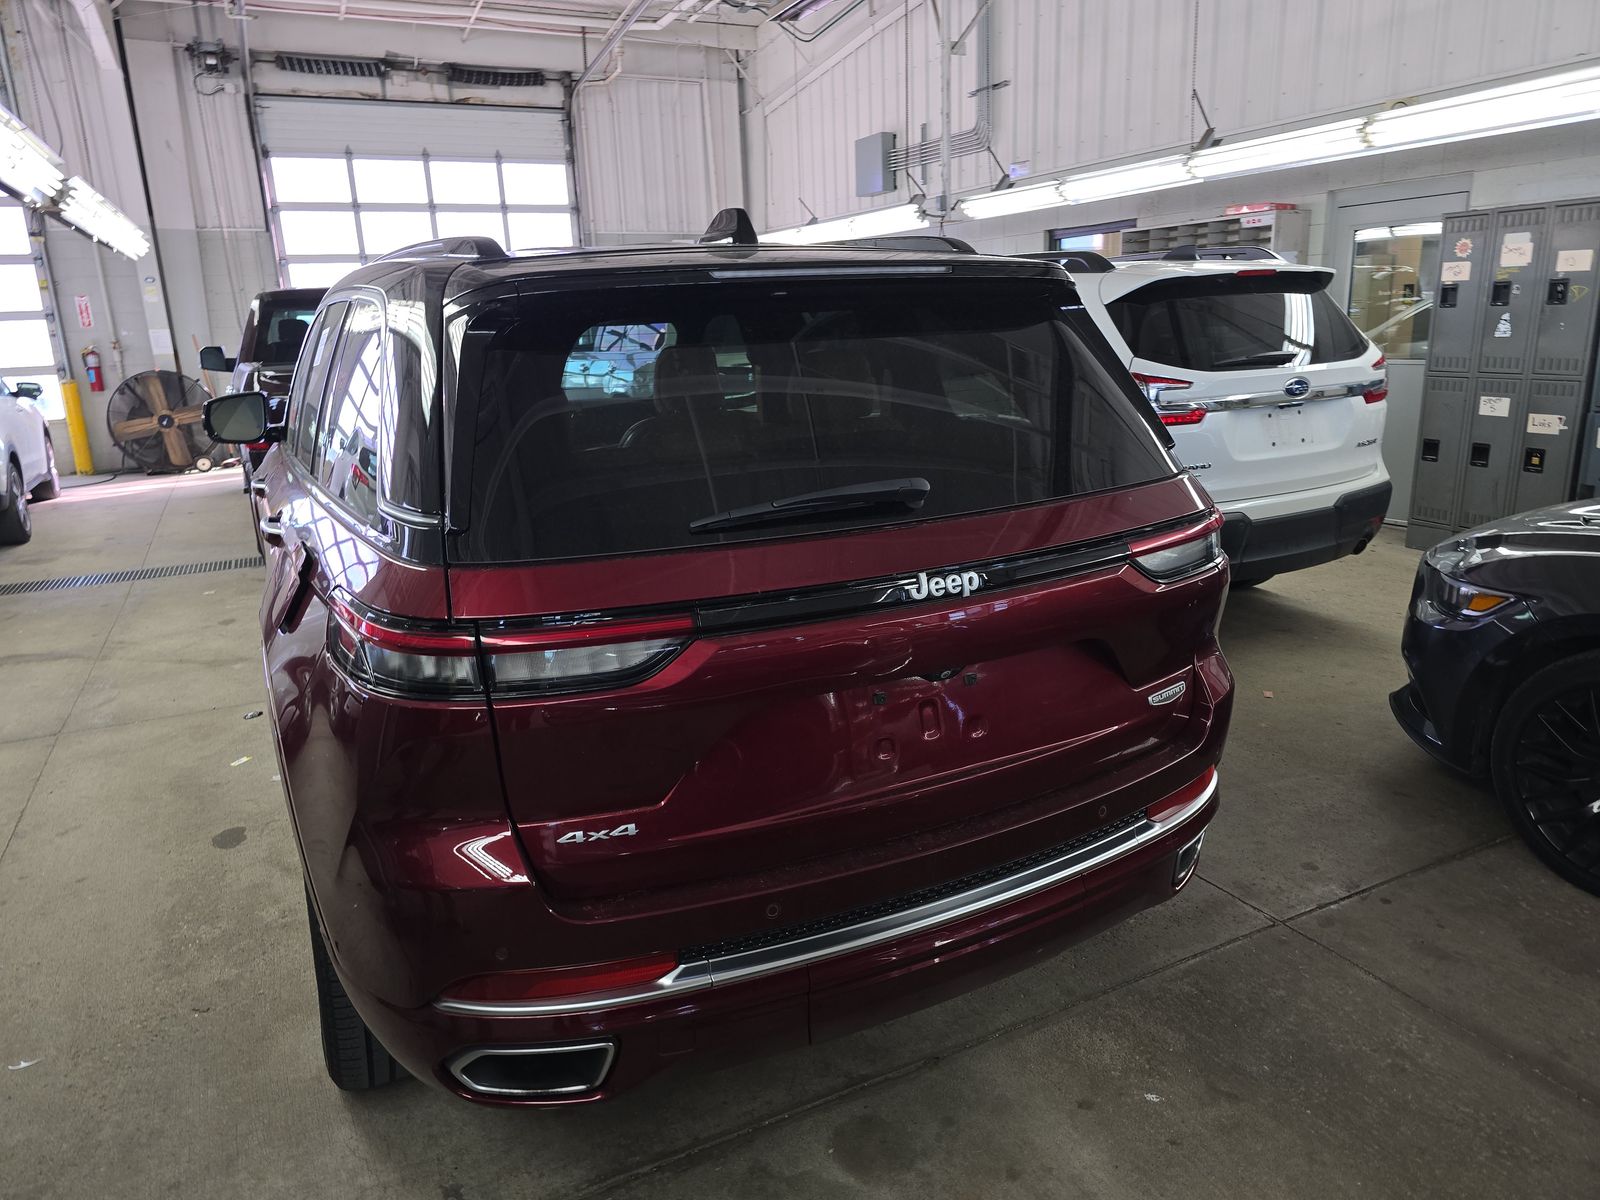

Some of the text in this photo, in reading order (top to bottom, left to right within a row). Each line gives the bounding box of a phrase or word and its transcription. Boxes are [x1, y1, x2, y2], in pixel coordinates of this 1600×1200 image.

[908, 571, 980, 600] Jeep
[1152, 684, 1184, 703] SUMMIT
[556, 823, 639, 844] 4x4
